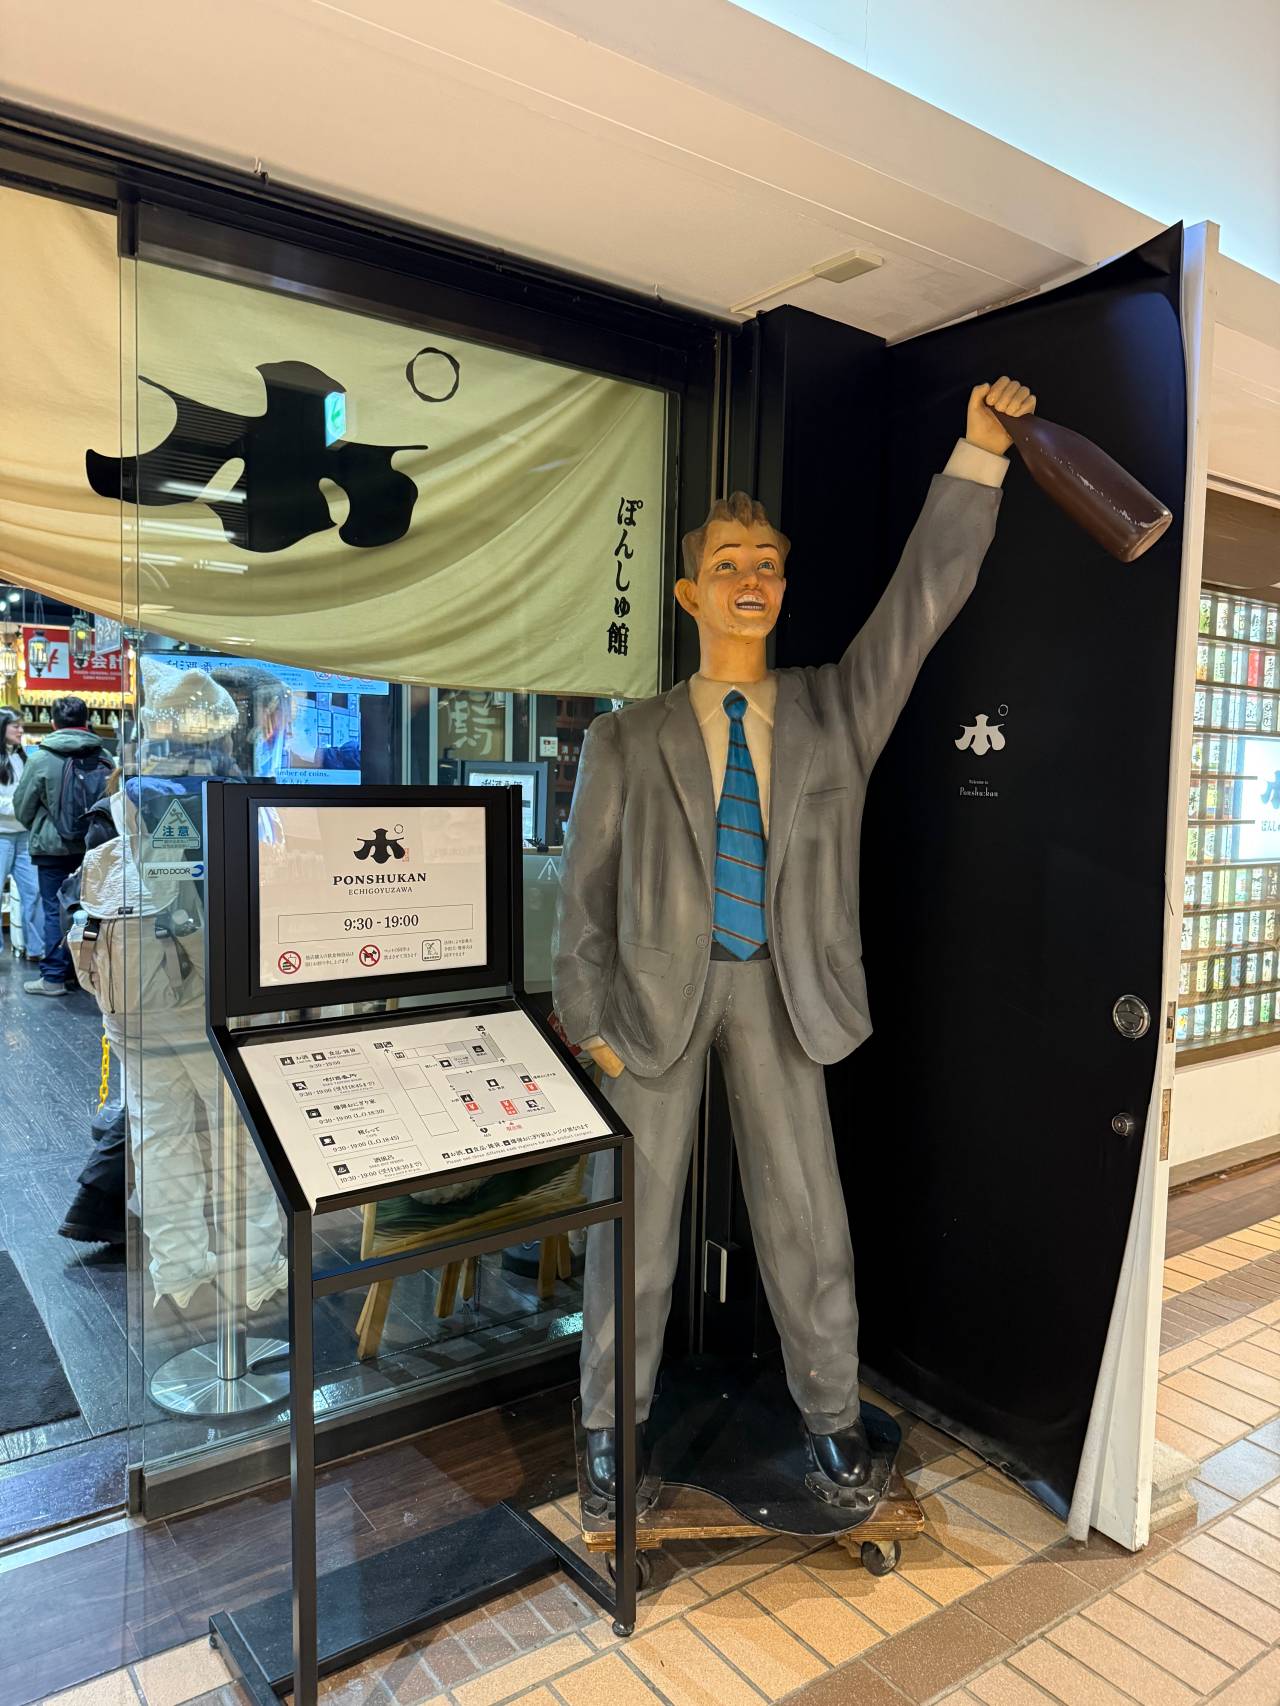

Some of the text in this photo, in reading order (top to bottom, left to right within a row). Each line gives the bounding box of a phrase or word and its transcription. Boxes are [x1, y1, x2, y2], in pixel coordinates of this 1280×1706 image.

[606, 497, 644, 656] ぽんしゅ館
[162, 825, 190, 837] 注意
[333, 872, 427, 886] PONSHUKAN
[348, 886, 413, 896] ECHIGOYUZAWA
[344, 917, 373, 932] 9:30
[384, 914, 419, 929] 19:00
[332, 1145, 347, 1153] 9:30
[350, 1141, 367, 1150] 19:00
[340, 1175, 357, 1184] 10:30
[360, 1170, 377, 1179] 19:00
